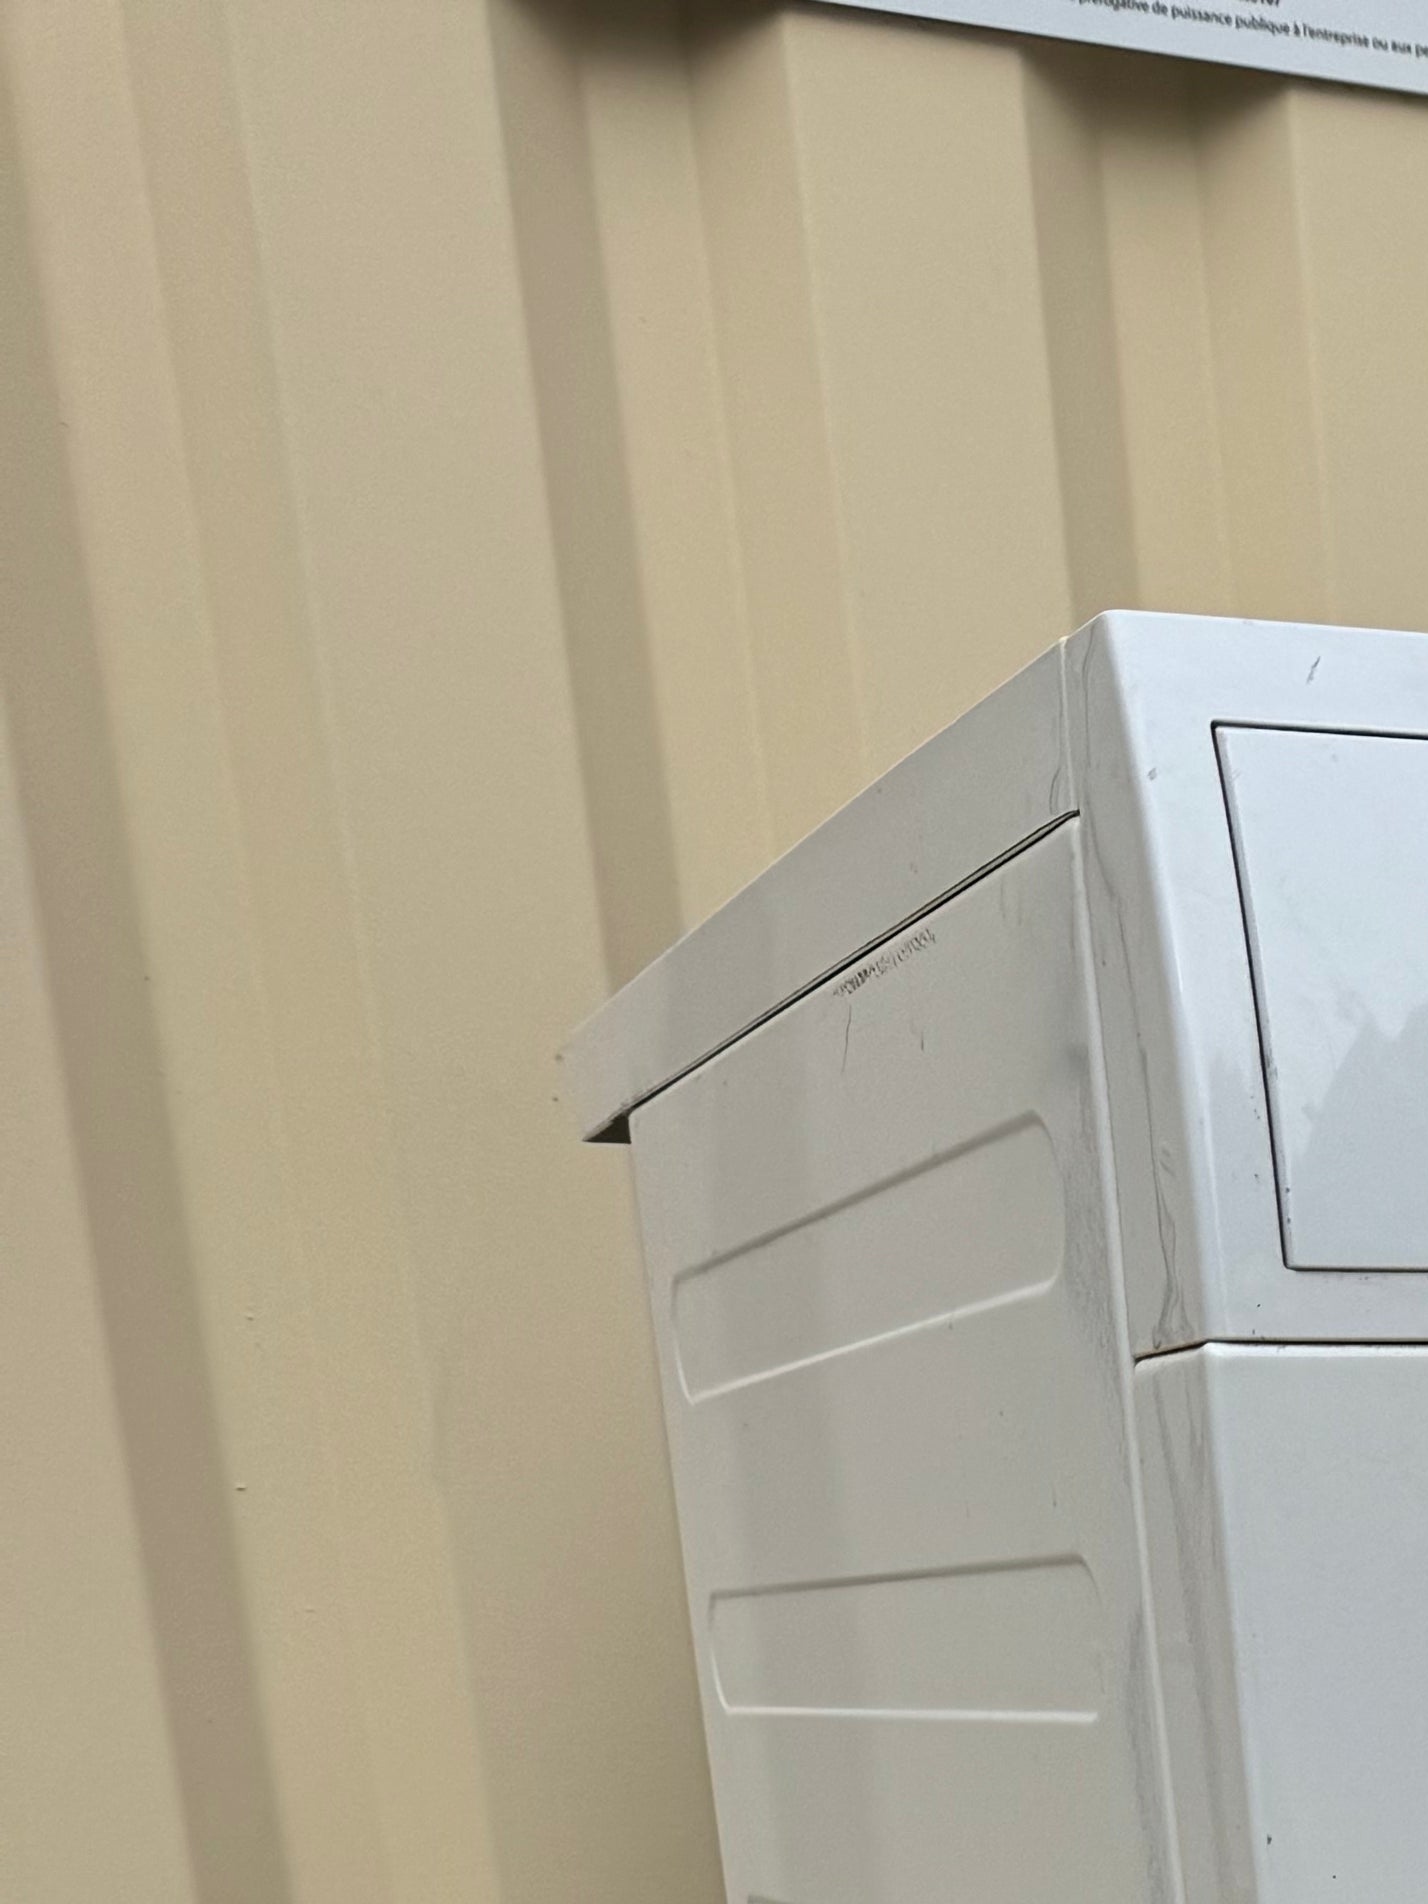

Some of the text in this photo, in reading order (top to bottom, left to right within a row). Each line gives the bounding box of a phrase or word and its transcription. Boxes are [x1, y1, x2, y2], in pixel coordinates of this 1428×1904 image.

[1151, 1, 1169, 17] de
[1171, 5, 1233, 27] puissance
[1234, 13, 1290, 36] publique
[1302, 22, 1370, 49] l'entreprise
[1371, 36, 1389, 52] ou
[1391, 39, 1412, 55] aux
